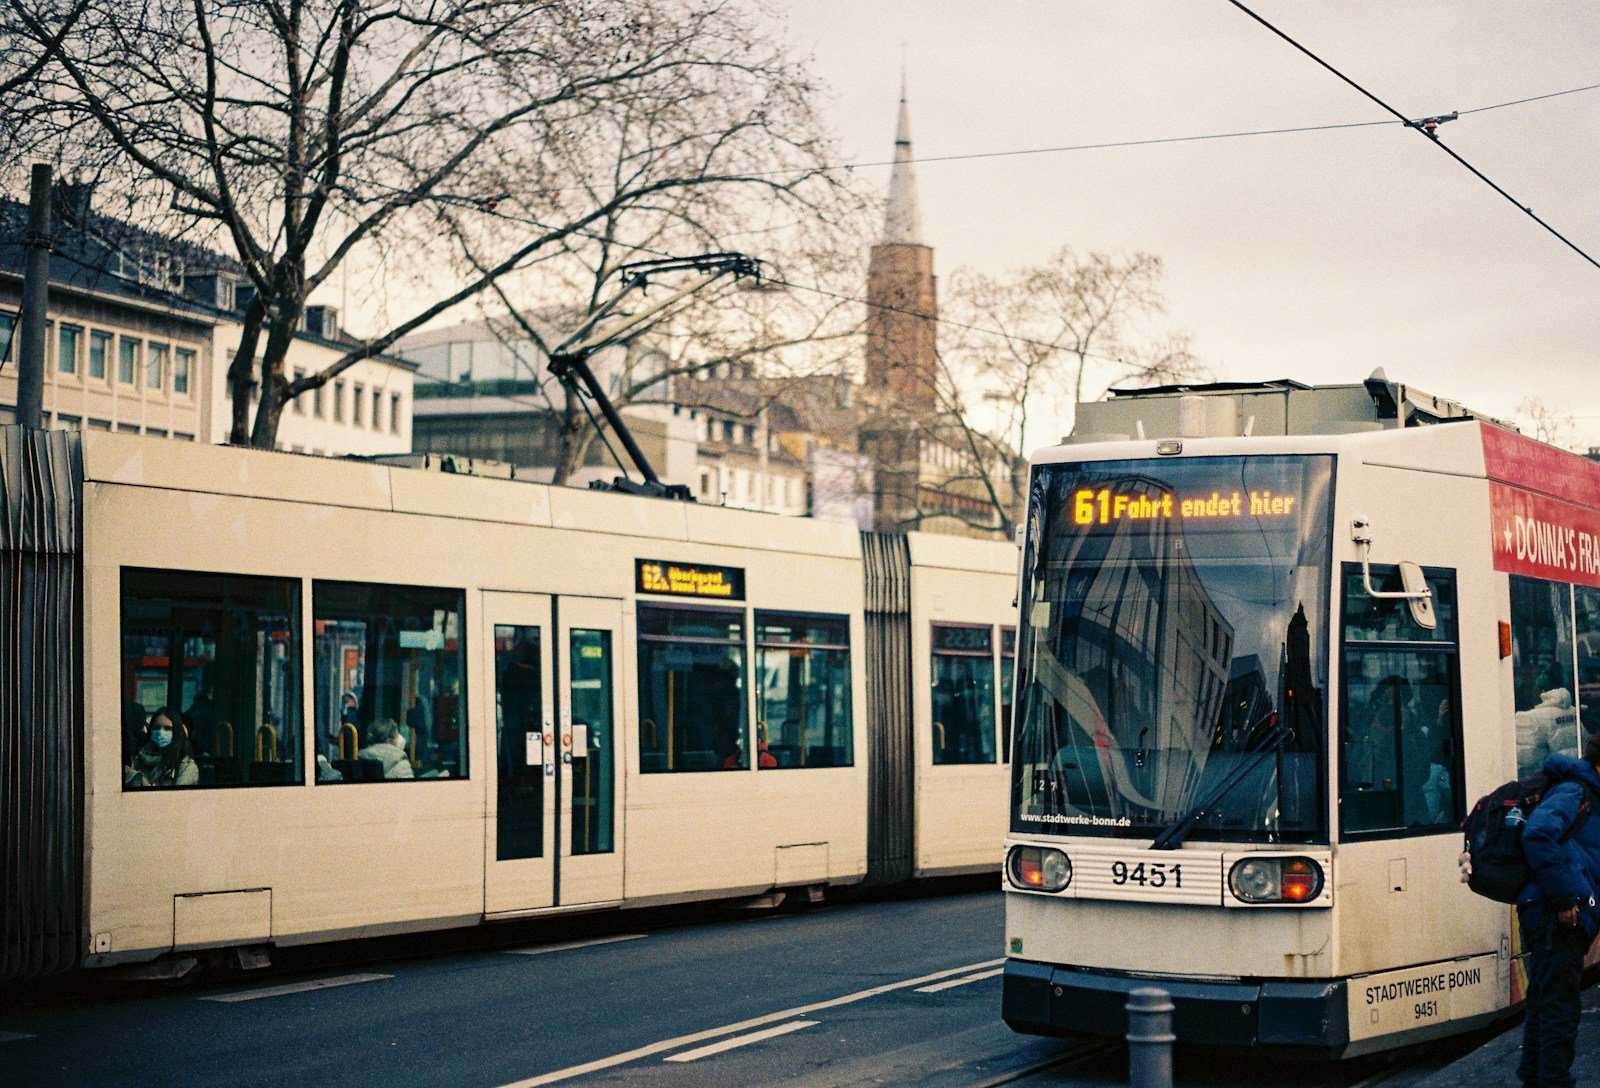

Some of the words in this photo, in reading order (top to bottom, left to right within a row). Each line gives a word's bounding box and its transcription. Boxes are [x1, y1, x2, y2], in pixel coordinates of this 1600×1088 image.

[1075, 489, 1110, 524] 61
[1114, 493, 1172, 519] Fahrt
[1181, 492, 1240, 517] endet
[1250, 491, 1294, 515] hier
[1515, 515, 1577, 571] DONNA'S
[1021, 814, 1131, 827] www.stadtwerke-bonn.de
[1112, 861, 1181, 888] 9451
[1366, 974, 1445, 1004] STADTWERKE
[1448, 968, 1481, 989] BONN
[1415, 1001, 1438, 1019] 9451
